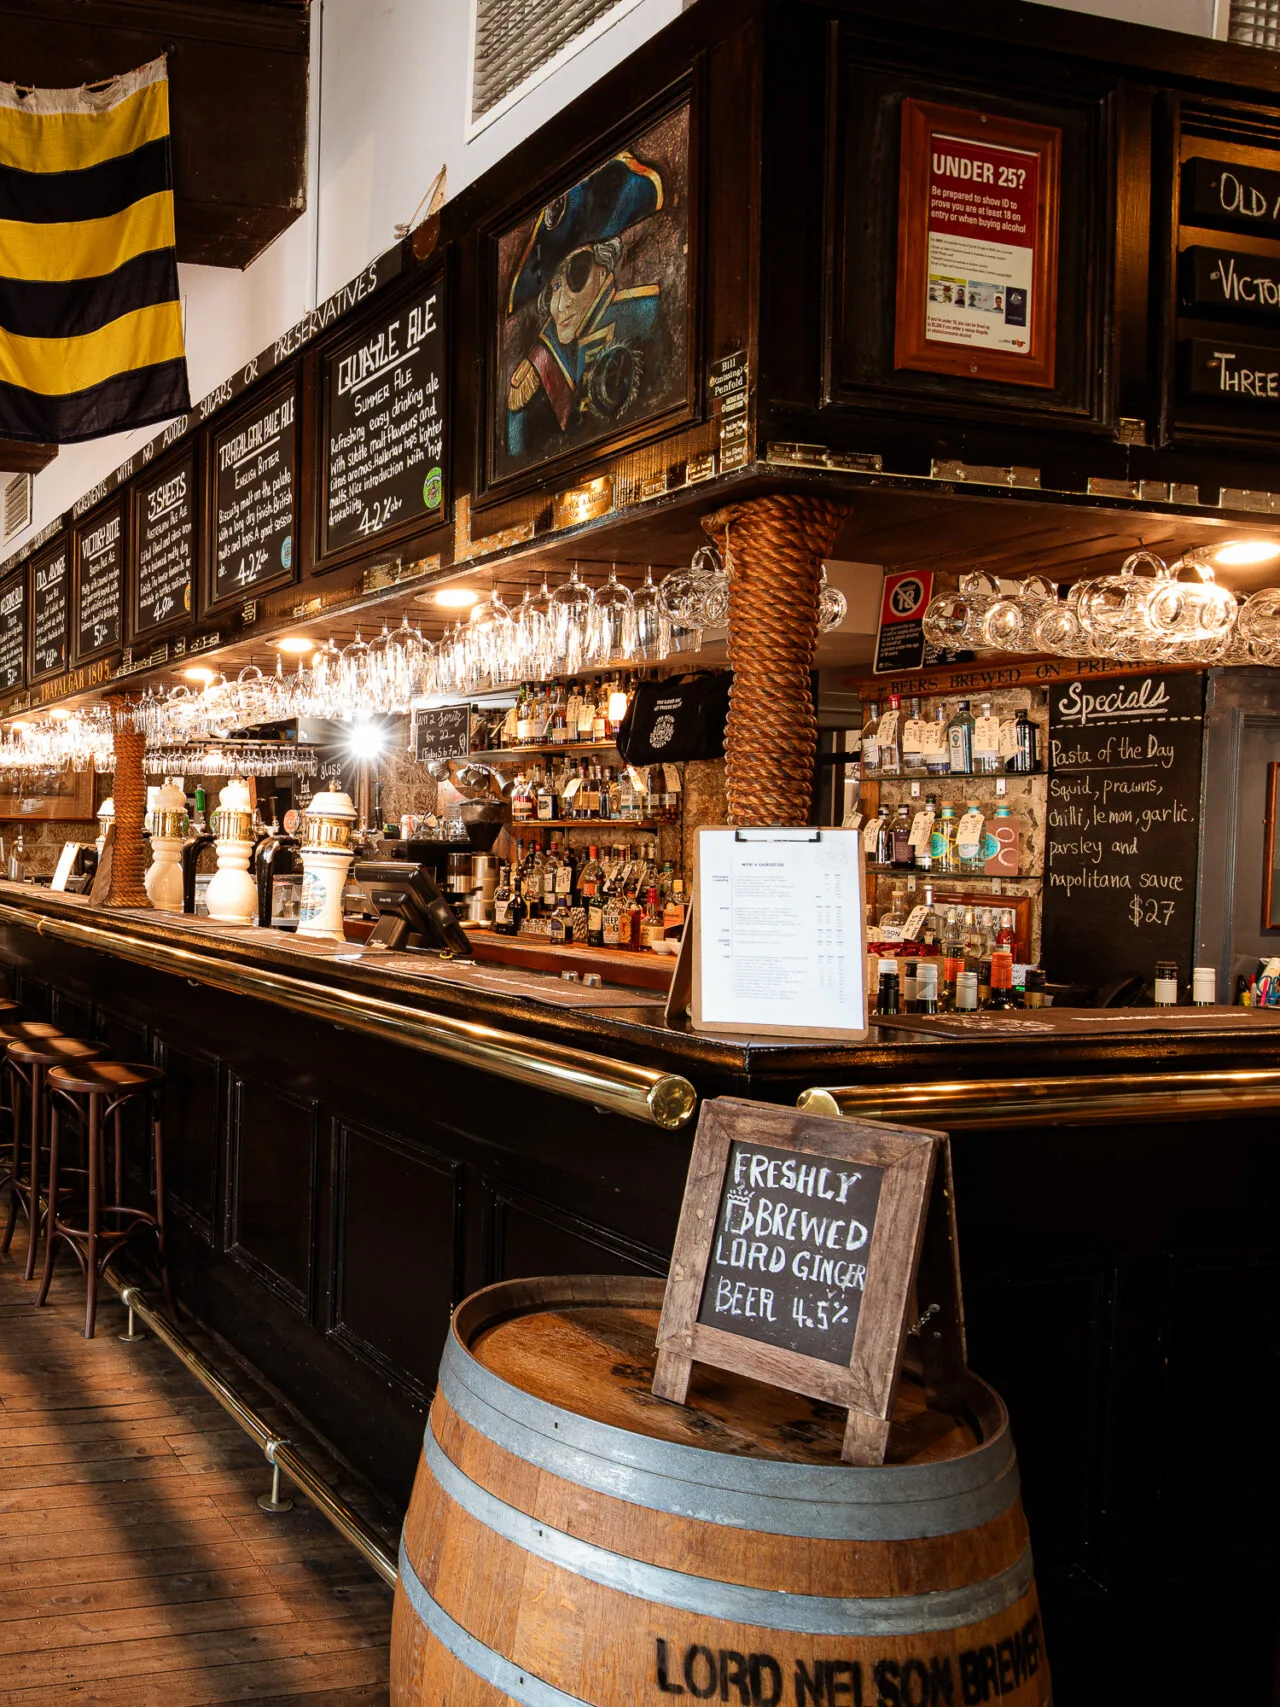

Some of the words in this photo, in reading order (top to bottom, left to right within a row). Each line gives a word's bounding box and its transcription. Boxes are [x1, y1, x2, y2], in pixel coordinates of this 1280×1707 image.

[932, 153, 994, 184] UNDER
[998, 166, 1026, 190] 25?
[931, 185, 942, 196] Be
[942, 189, 973, 202] prepared
[974, 194, 982, 204] to
[982, 196, 1001, 207] show
[1001, 198, 1010, 208] ID
[1010, 201, 1018, 210] to
[931, 199, 951, 209] prove
[951, 202, 965, 212] you
[965, 205, 977, 214] are
[978, 206, 985, 216] at
[986, 207, 1003, 218] least
[1004, 210, 1012, 220] 18
[1012, 213, 1022, 222] on
[1220, 172, 1267, 217] OLD
[930, 210, 950, 222] entry
[950, 213, 958, 222] or
[958, 214, 978, 225] when
[979, 217, 1001, 231] buying
[1001, 222, 1027, 234] alcohol
[1218, 258, 1280, 306] VICTO
[338, 320, 400, 396] QUAYLE
[406, 294, 437, 349] ALE
[117, 459, 133, 483] WITH
[142, 442, 154, 465] NO
[163, 414, 188, 449] ADDED
[200, 377, 233, 420] SUGARS
[244, 359, 259, 385] OR
[274, 263, 378, 364] PRESERVATIVES
[715, 366, 744, 384] (missing)
[721, 357, 736, 372] Bill
[1213, 351, 1280, 398] THREE
[354, 384, 390, 417] SUMMER
[394, 368, 413, 392] ALE
[714, 376, 743, 397] Penfold
[331, 426, 366, 456] Refreshing
[370, 410, 390, 430] easy
[392, 388, 423, 418] drinking
[426, 372, 440, 394] ale
[348, 444, 368, 466] subtle
[370, 432, 386, 454] malt
[387, 412, 418, 442] flavours
[419, 397, 438, 423] and
[219, 420, 263, 472] TRAFALGAR
[263, 407, 280, 441] PALE
[281, 396, 294, 430] ALE
[419, 419, 443, 448] lighter
[257, 450, 280, 477] BITTER
[273, 466, 292, 496] palate
[349, 481, 362, 498] Nice
[363, 460, 404, 492] introduction
[147, 491, 157, 520] 3
[156, 472, 187, 513] SHEETS
[274, 511, 293, 532] sessio
[40, 669, 84, 702] TRAFALGAR
[890, 676, 939, 695] BEERS
[949, 667, 1021, 689] BREWED
[1036, 662, 1062, 680] ON
[430, 713, 436, 725] 2
[437, 710, 465, 727] Spritz
[1059, 678, 1170, 725] Specials
[1051, 740, 1092, 768] Pasta
[1097, 736, 1117, 763] of
[1117, 736, 1143, 759] the
[1146, 733, 1174, 769] Day
[320, 761, 341, 780] glass
[1050, 775, 1099, 802] Squid,
[1103, 779, 1163, 804] prawns,
[1049, 805, 1090, 831] chilli,
[1093, 804, 1140, 826] lemon,
[1049, 836, 1102, 867] parsley
[1111, 836, 1139, 855] and
[1049, 867, 1132, 897] napolitana
[1139, 873, 1184, 891] sauce
[602, 916, 619, 924] HEEP
[1128, 893, 1176, 928] $27
[734, 1151, 863, 1205] FRESHLY
[755, 1197, 869, 1251] BREWED
[715, 1234, 786, 1273] LORD
[791, 1250, 866, 1292] GINGER
[715, 1276, 777, 1322] BEER
[792, 1296, 849, 1330] 4.5%
[656, 1637, 783, 1707] LORD
[794, 1655, 954, 1707] NELSON
[959, 1613, 1042, 1704] BREWE
